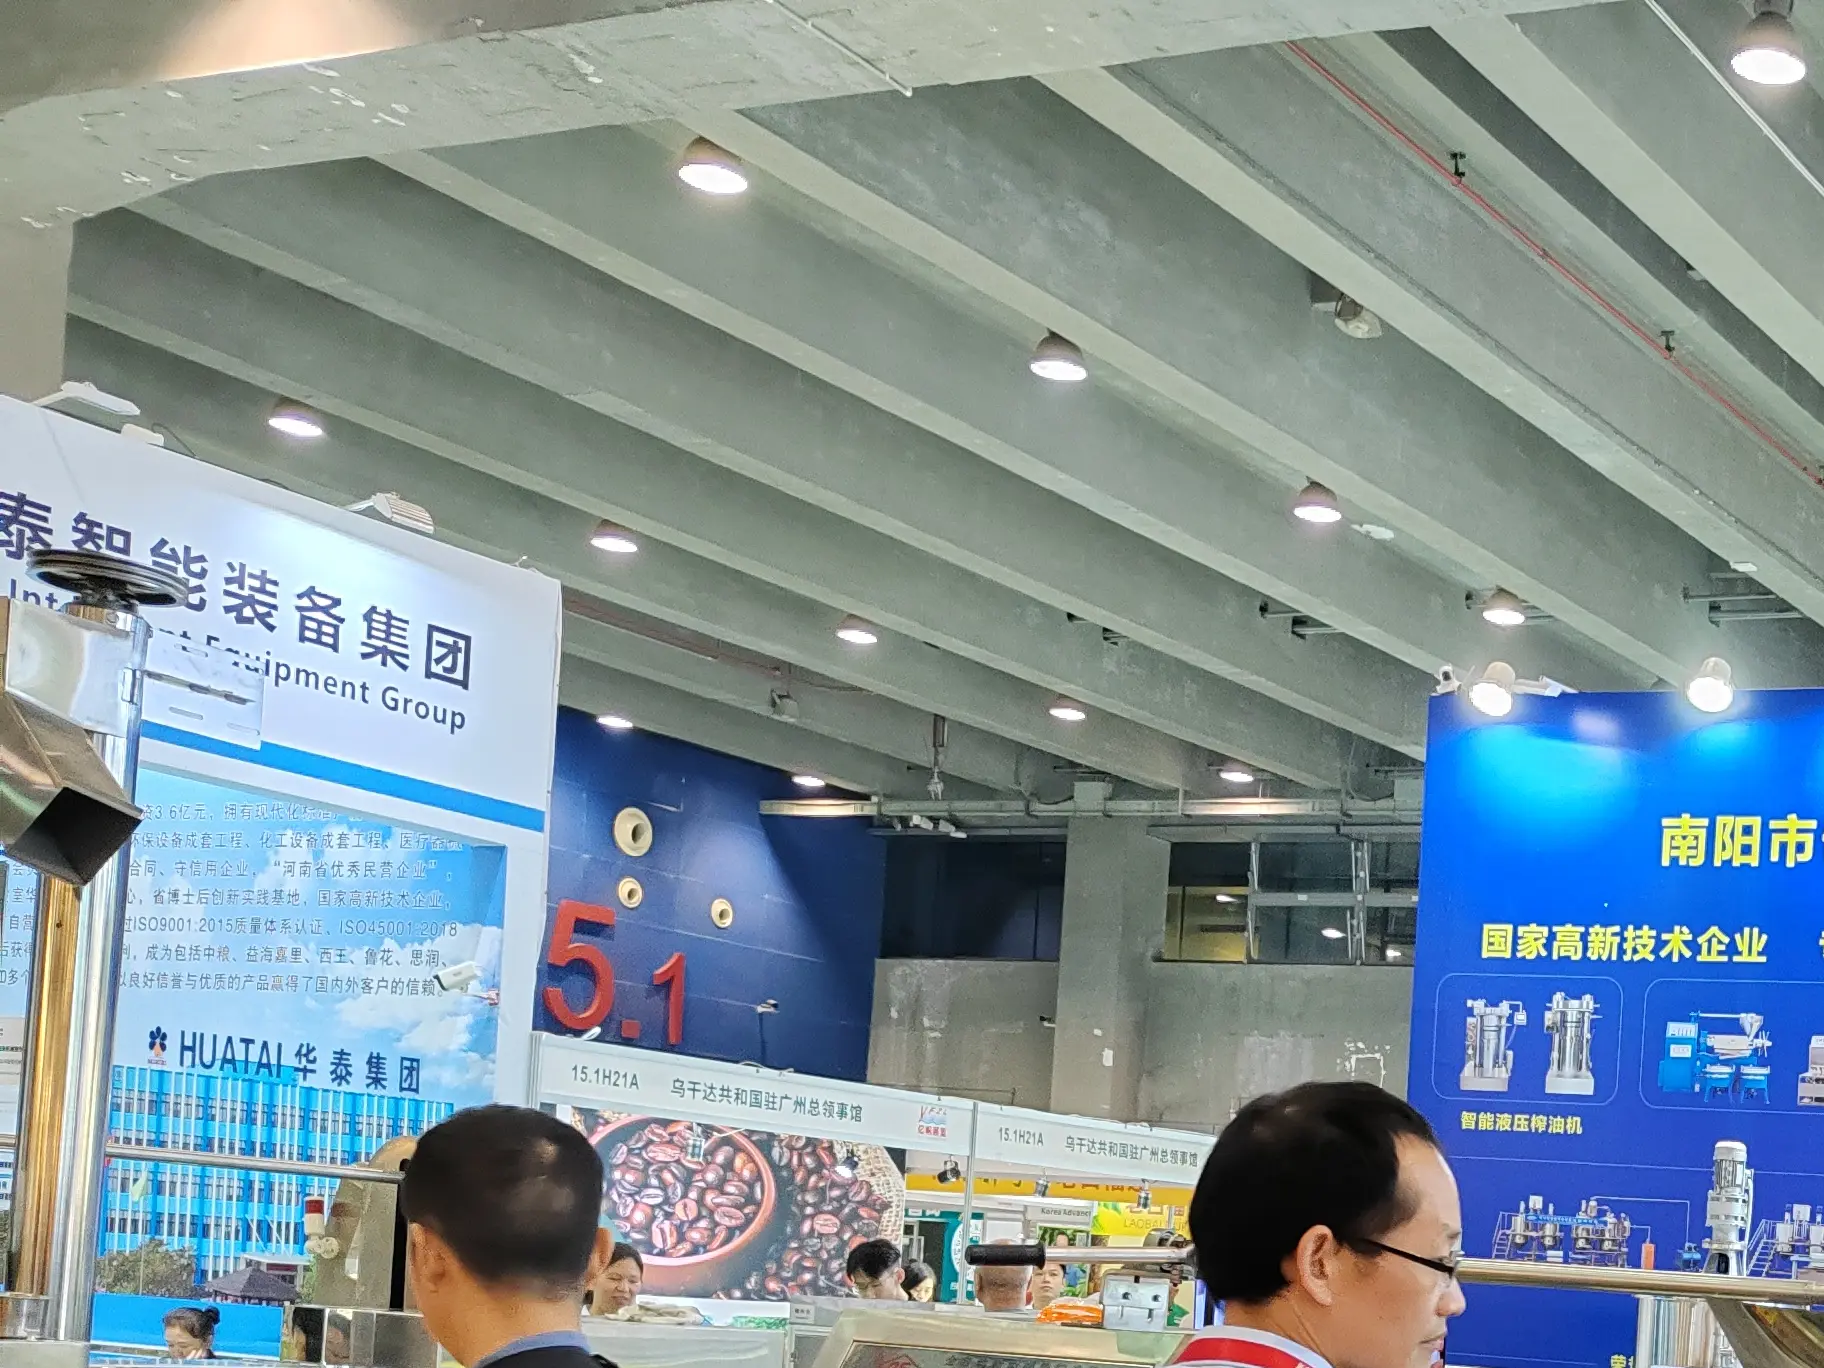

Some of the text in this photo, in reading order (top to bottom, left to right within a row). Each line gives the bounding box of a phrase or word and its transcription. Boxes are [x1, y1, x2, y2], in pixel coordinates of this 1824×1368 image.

[381, 687, 466, 733] Group
[1481, 924, 1767, 965] 国家高新技术企业
[179, 1029, 421, 1095] HUATAI 华泰集团
[571, 1064, 863, 1123] 15.1H21A 乌干达共和国驻广州总领事馆
[1461, 1110, 1583, 1136] 智能液压榨油机
[998, 1126, 1199, 1168] 15.1H21A 乌干达共和国驻广州总领事馆
[1040, 1207, 1061, 1216] Korea
